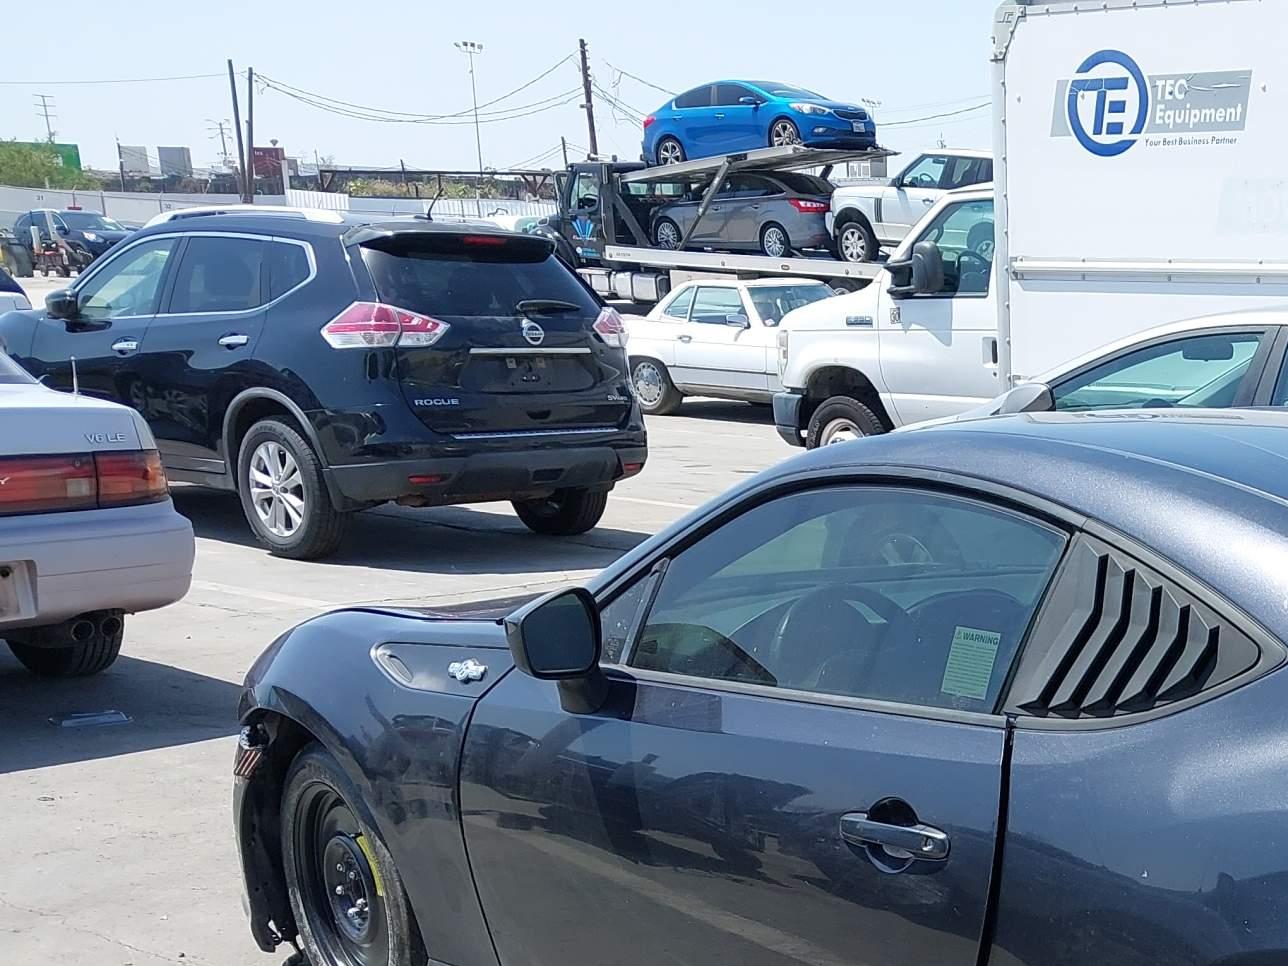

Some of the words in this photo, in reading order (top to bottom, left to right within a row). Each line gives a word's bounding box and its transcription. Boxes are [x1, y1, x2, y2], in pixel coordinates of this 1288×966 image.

[1155, 79, 1189, 100] TEC
[1154, 103, 1242, 129] Equipment
[1145, 138, 1161, 147] Your
[1162, 137, 1177, 146] Best
[1178, 136, 1209, 146] Business
[1210, 135, 1237, 145] Partner
[414, 398, 460, 407] ROGUE
[84, 433, 104, 444] V6
[106, 433, 127, 443] LE
[962, 631, 999, 645] WARNING
